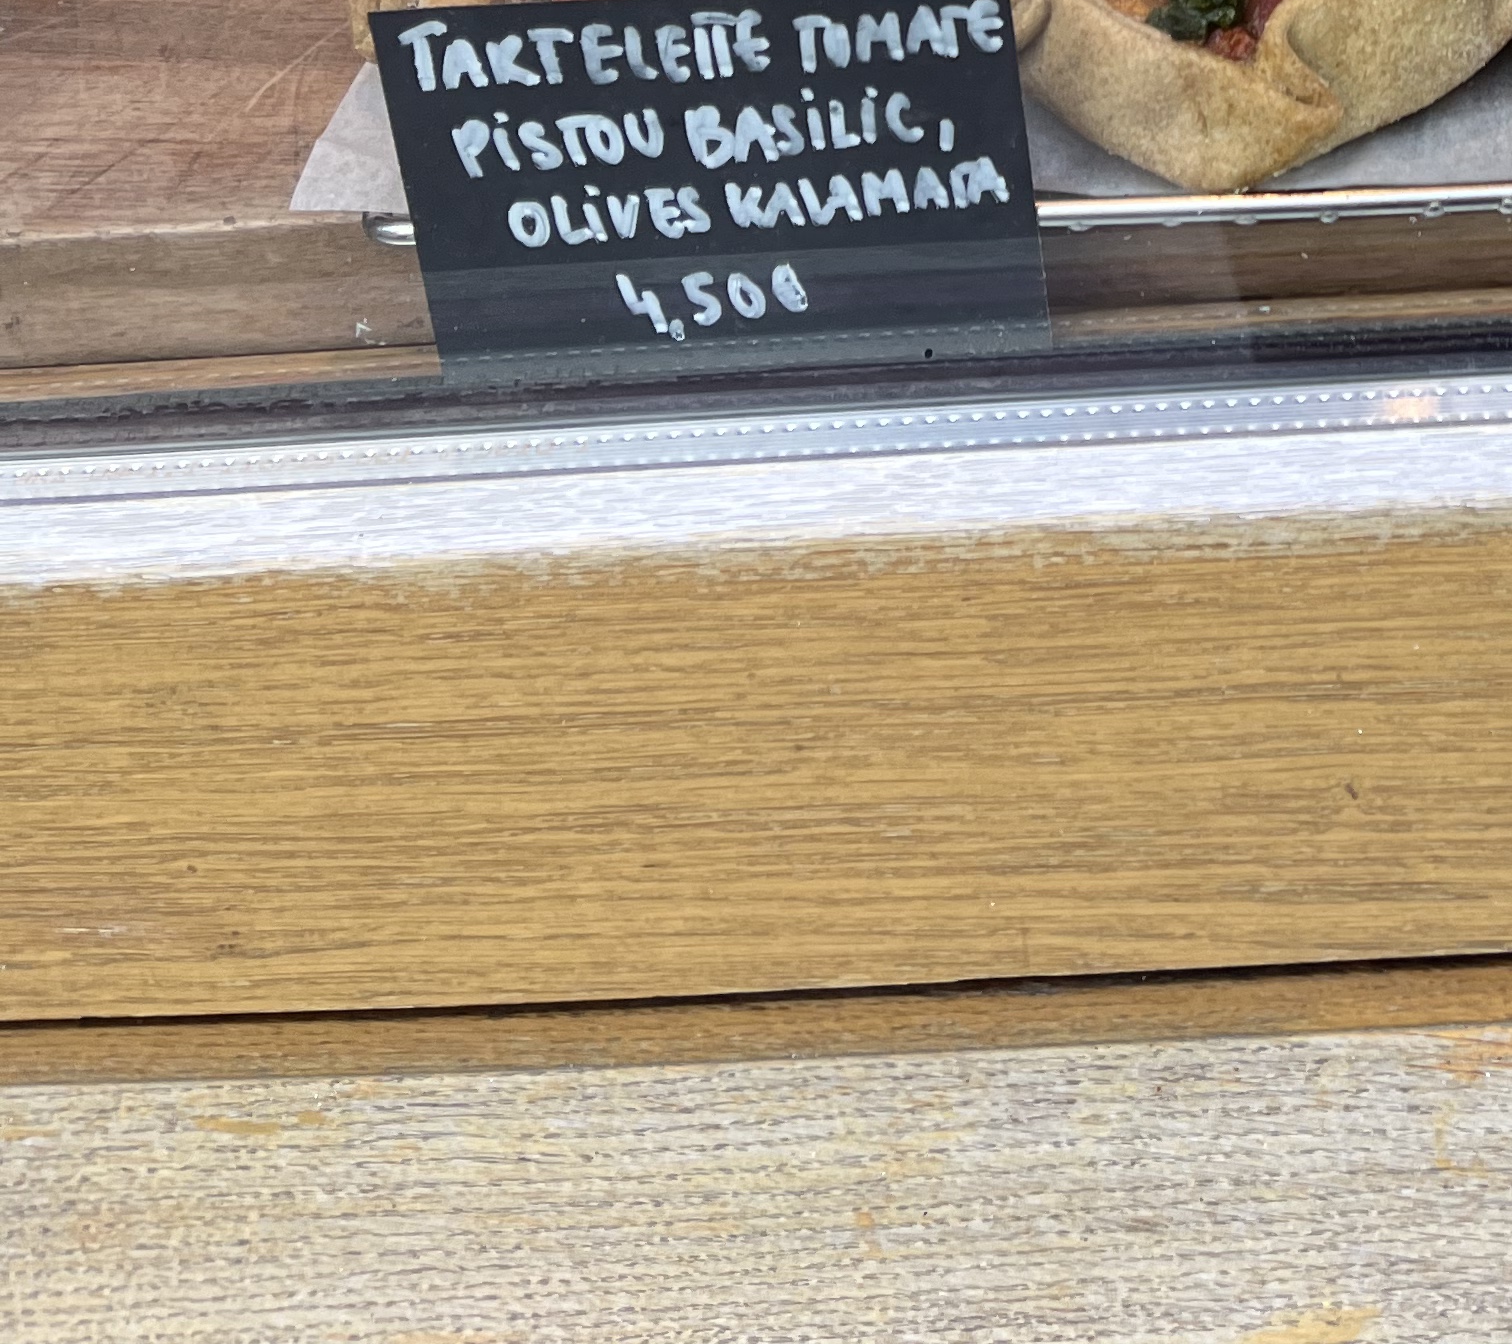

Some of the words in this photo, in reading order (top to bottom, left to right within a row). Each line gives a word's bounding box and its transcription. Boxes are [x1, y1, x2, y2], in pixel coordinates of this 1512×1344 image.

[398, 10, 770, 91] TARTELETTE
[794, 0, 1003, 72] TOMATE
[725, 157, 1009, 227] KALAMATA
